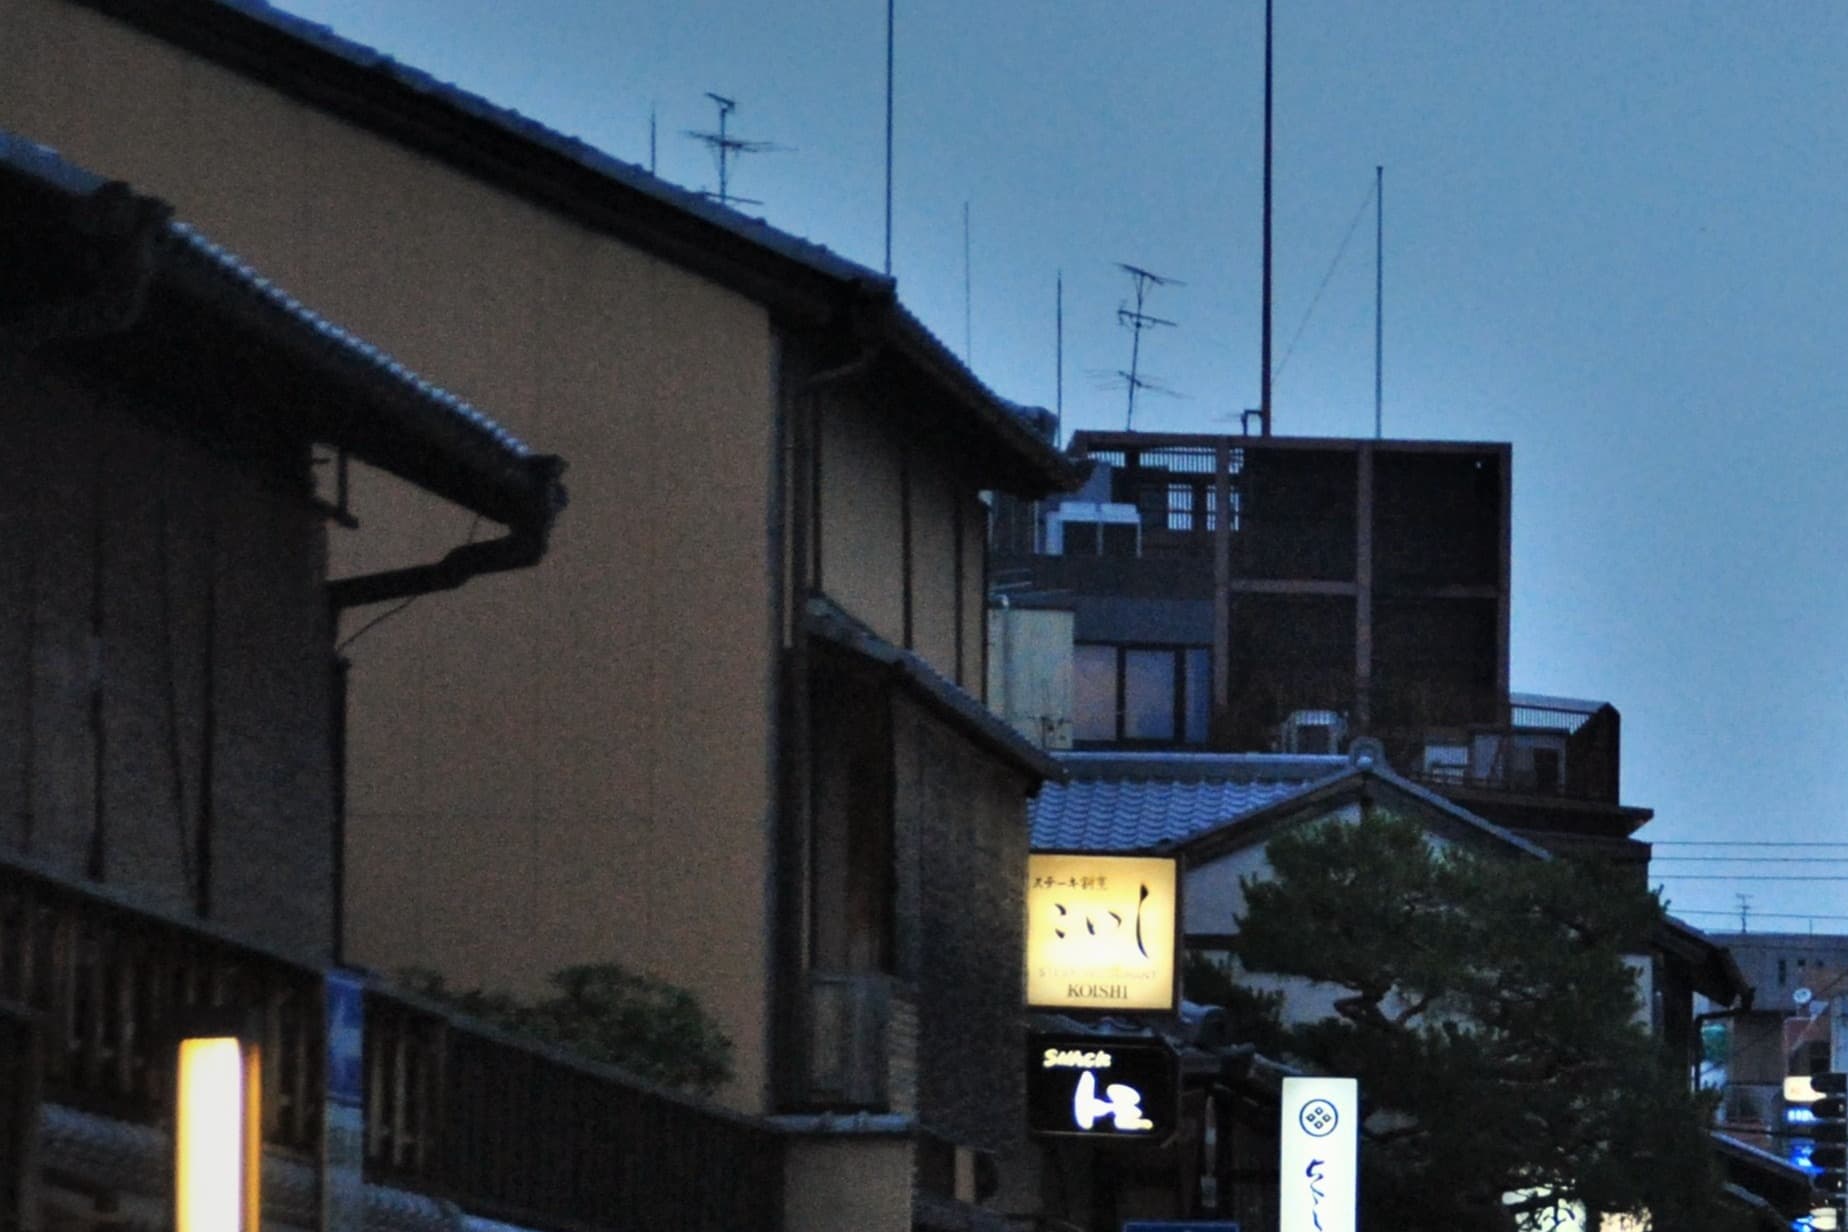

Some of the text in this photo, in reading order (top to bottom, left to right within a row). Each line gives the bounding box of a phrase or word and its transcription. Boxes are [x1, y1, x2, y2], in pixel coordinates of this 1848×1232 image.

[1054, 883, 1149, 960] こいし
[1067, 984, 1129, 999] KOISHI
